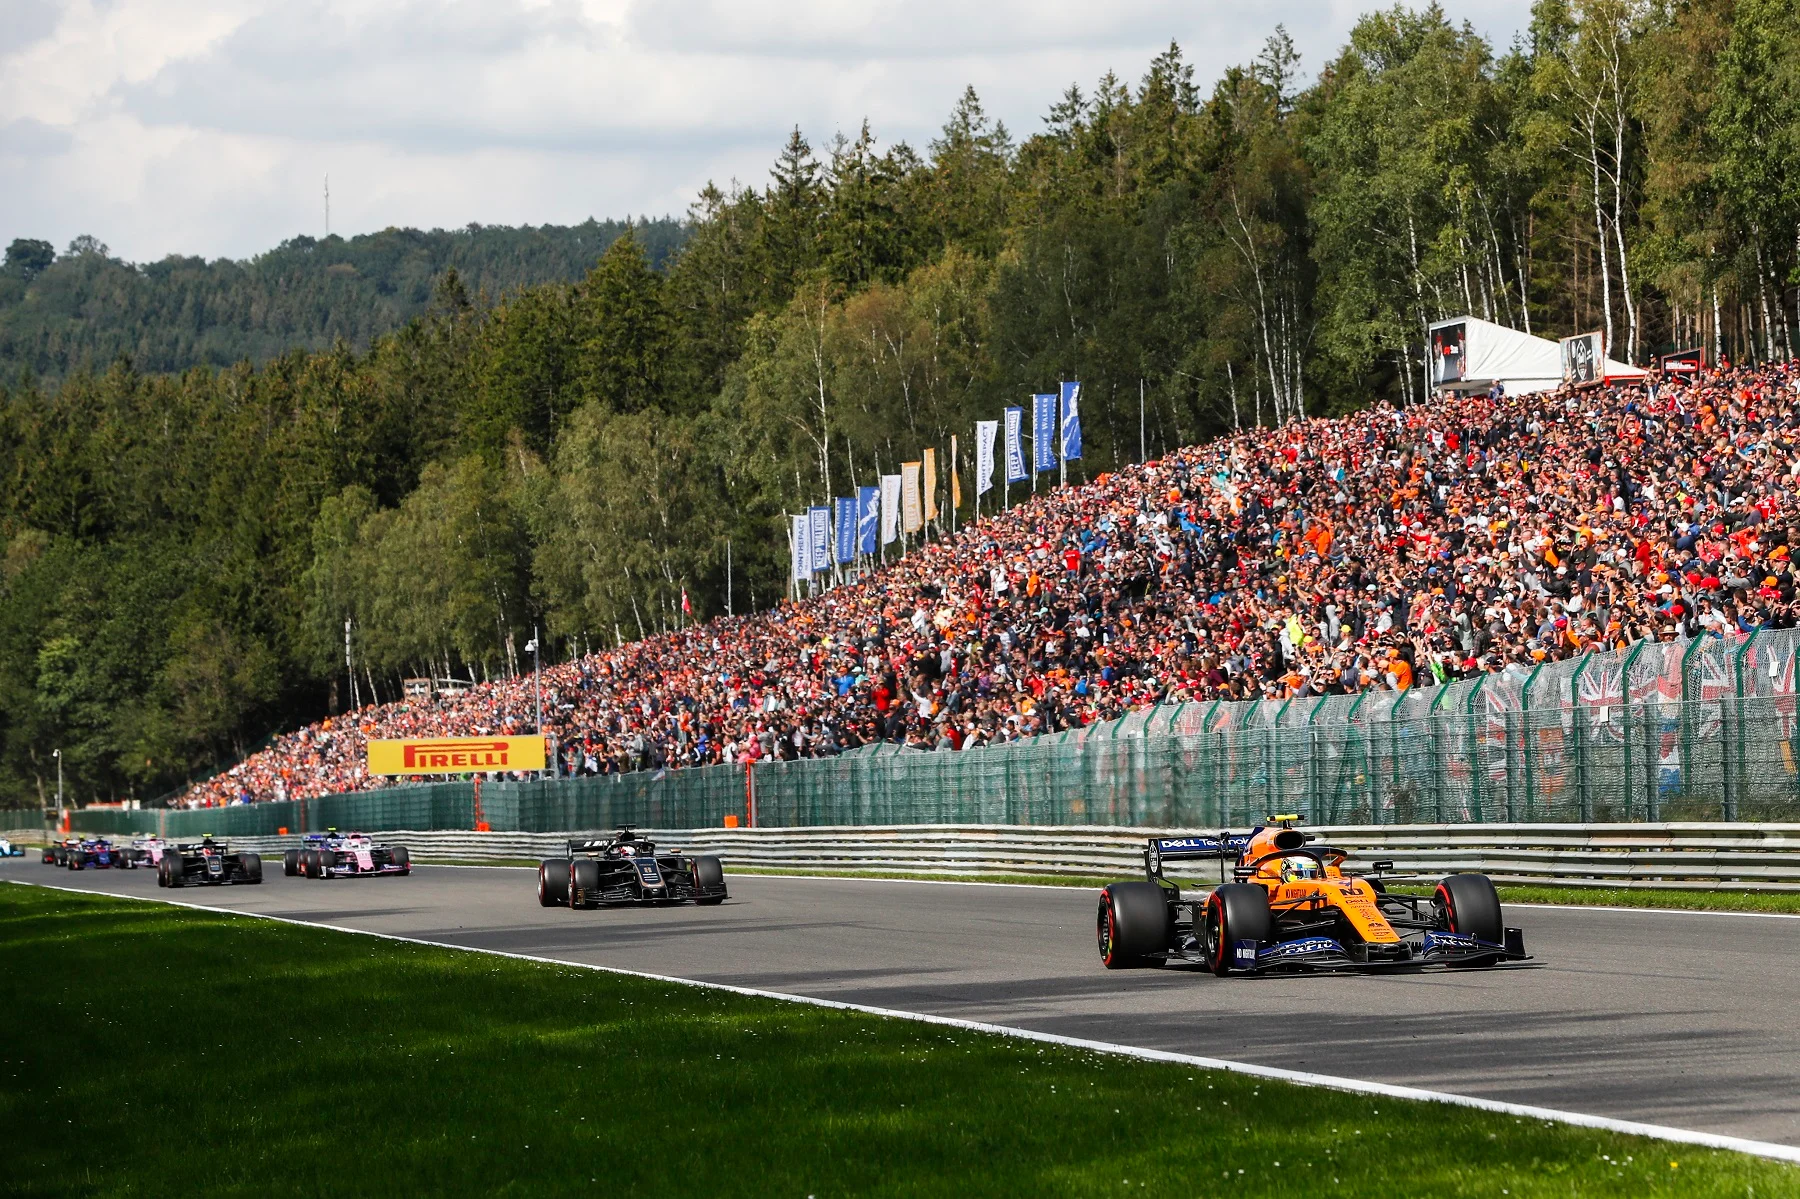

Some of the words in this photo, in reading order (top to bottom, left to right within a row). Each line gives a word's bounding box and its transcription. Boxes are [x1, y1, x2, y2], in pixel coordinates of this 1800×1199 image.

[1041, 397, 1049, 430] WALKER
[1009, 413, 1018, 453] WALKING
[1041, 432, 1050, 467] JOHNNIE
[1010, 453, 1022, 476] KEEP
[843, 500, 851, 529] WALKER
[907, 507, 917, 528] KEEP
[814, 513, 825, 547] WALKING
[814, 547, 825, 567] KEEP
[403, 741, 509, 768] PIRELLI
[1161, 839, 1199, 848] DELL
